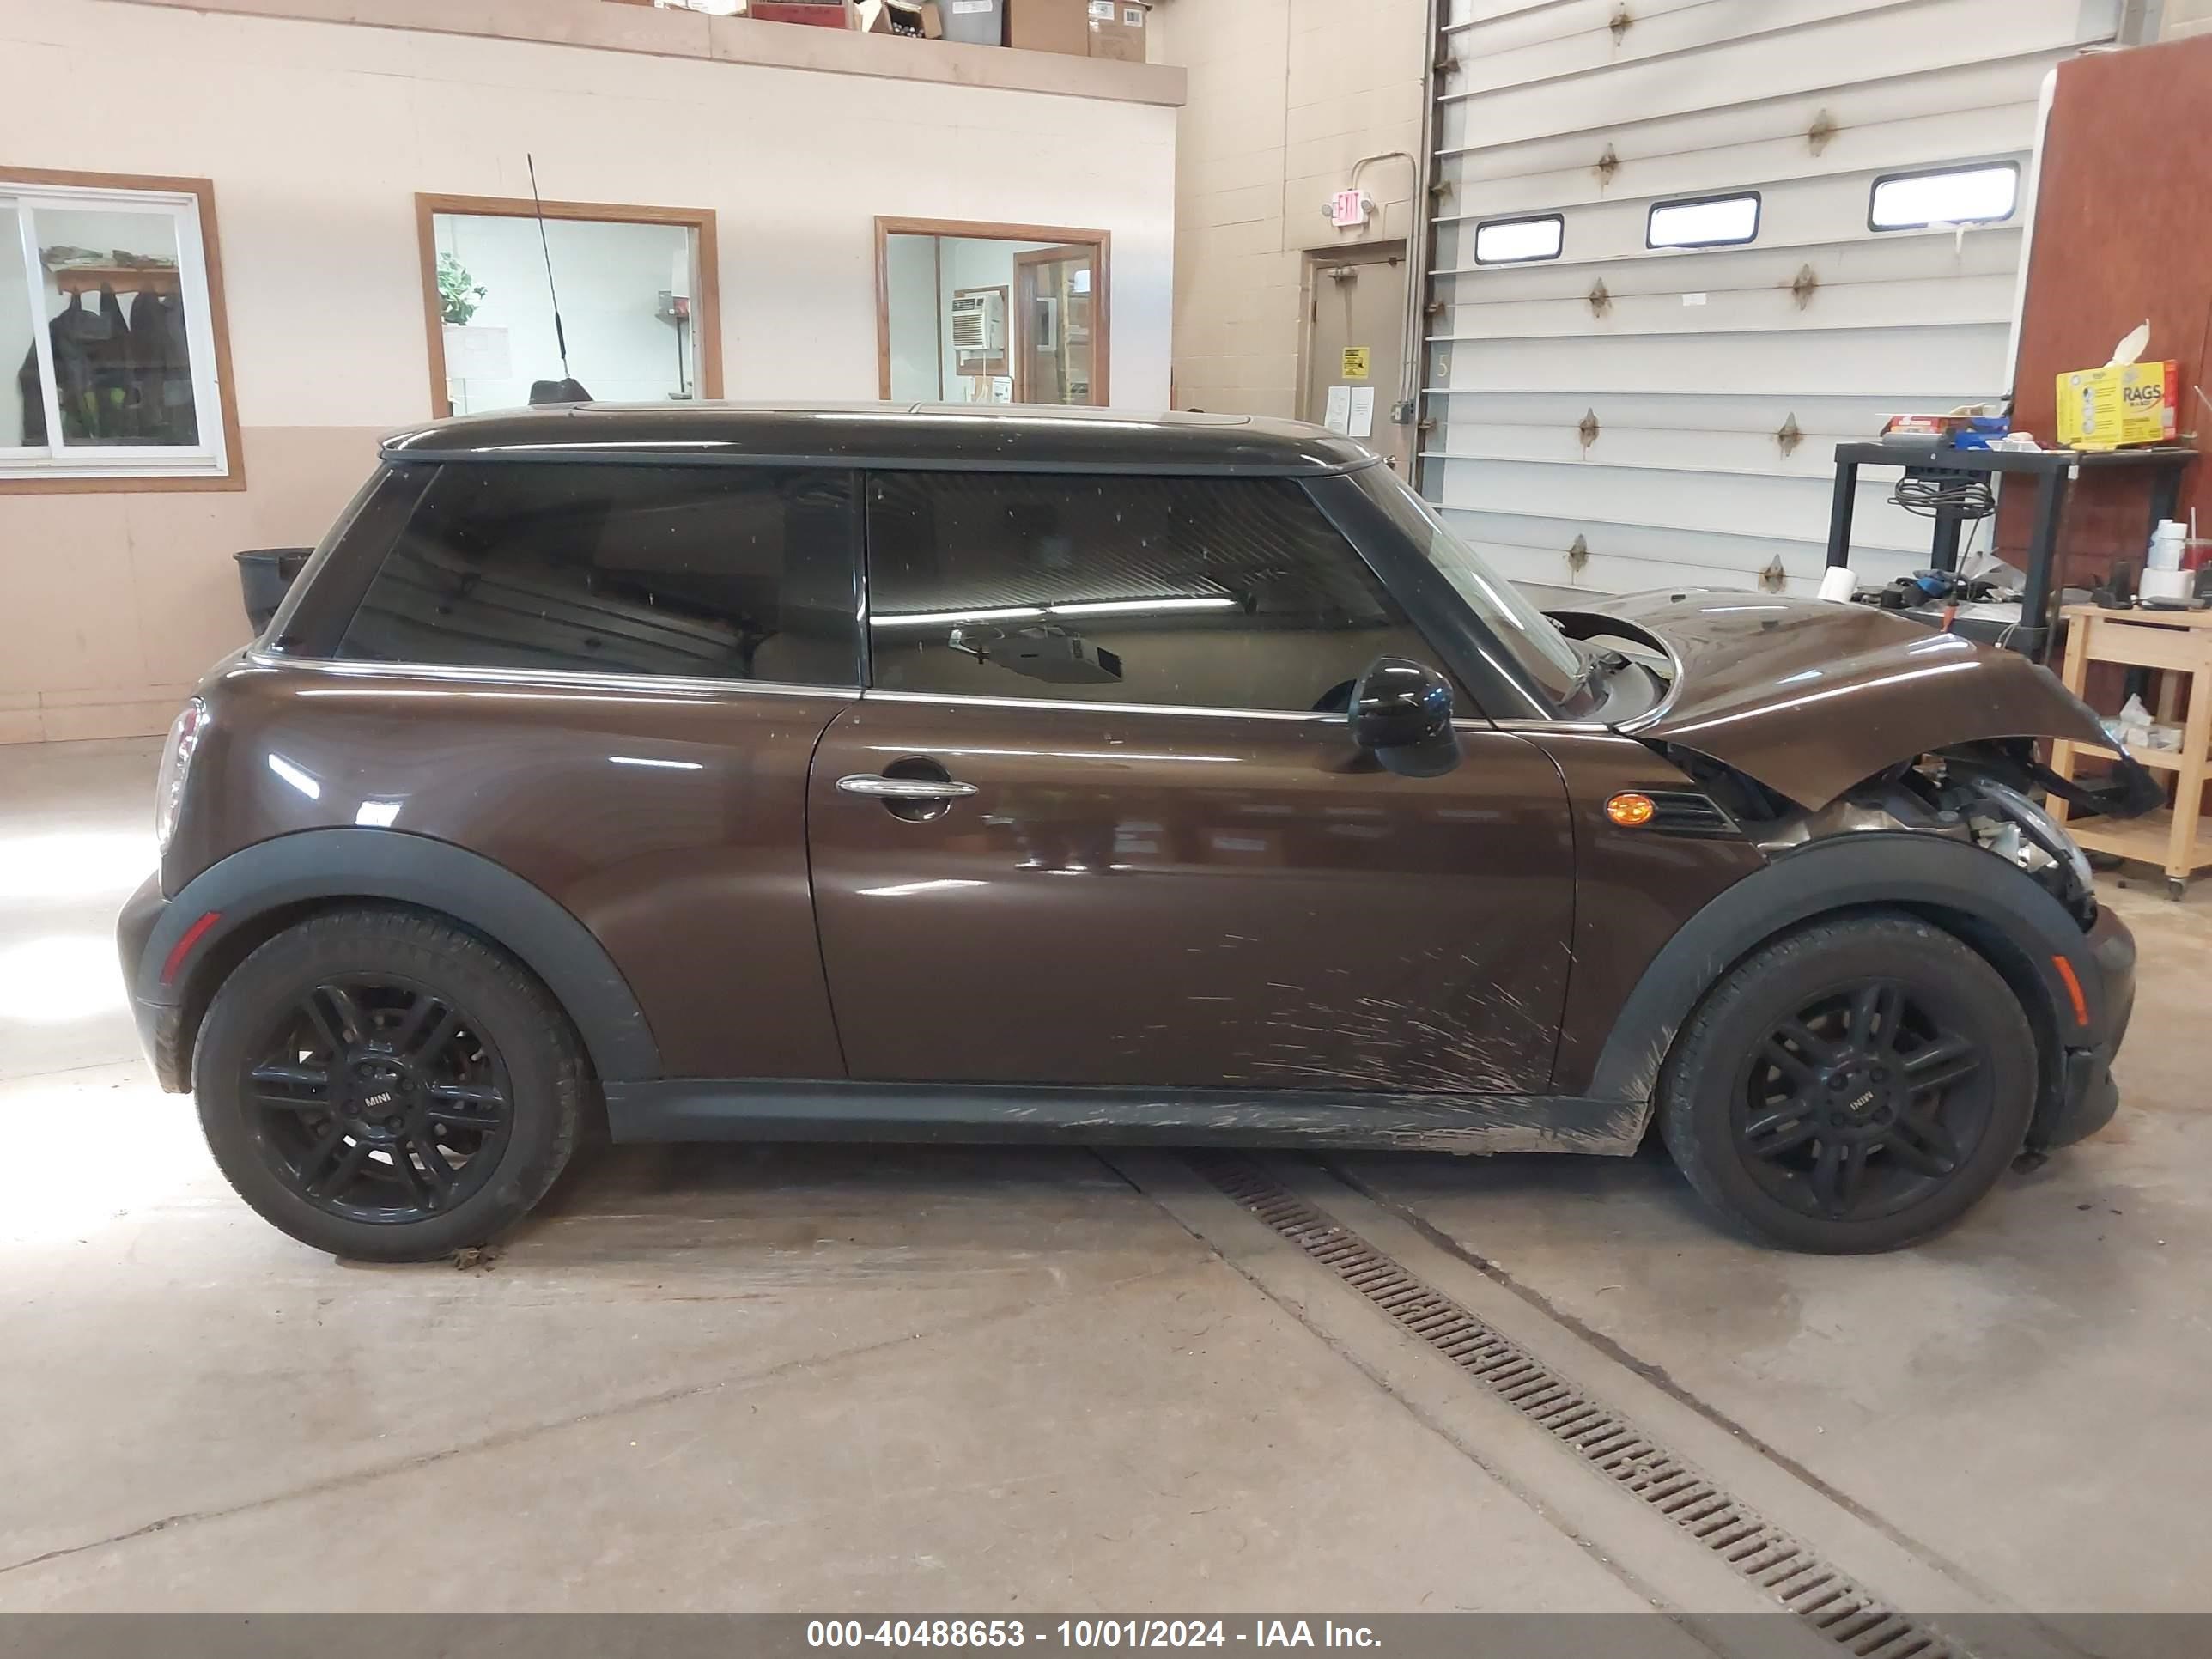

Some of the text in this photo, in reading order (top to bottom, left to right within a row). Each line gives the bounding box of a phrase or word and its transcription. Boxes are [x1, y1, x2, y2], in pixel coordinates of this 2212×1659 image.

[1437, 354, 1449, 377] 5
[2123, 384, 2161, 402] RAGS
[365, 1091, 392, 1107] MINI
[1849, 1091, 1874, 1111] MINI
